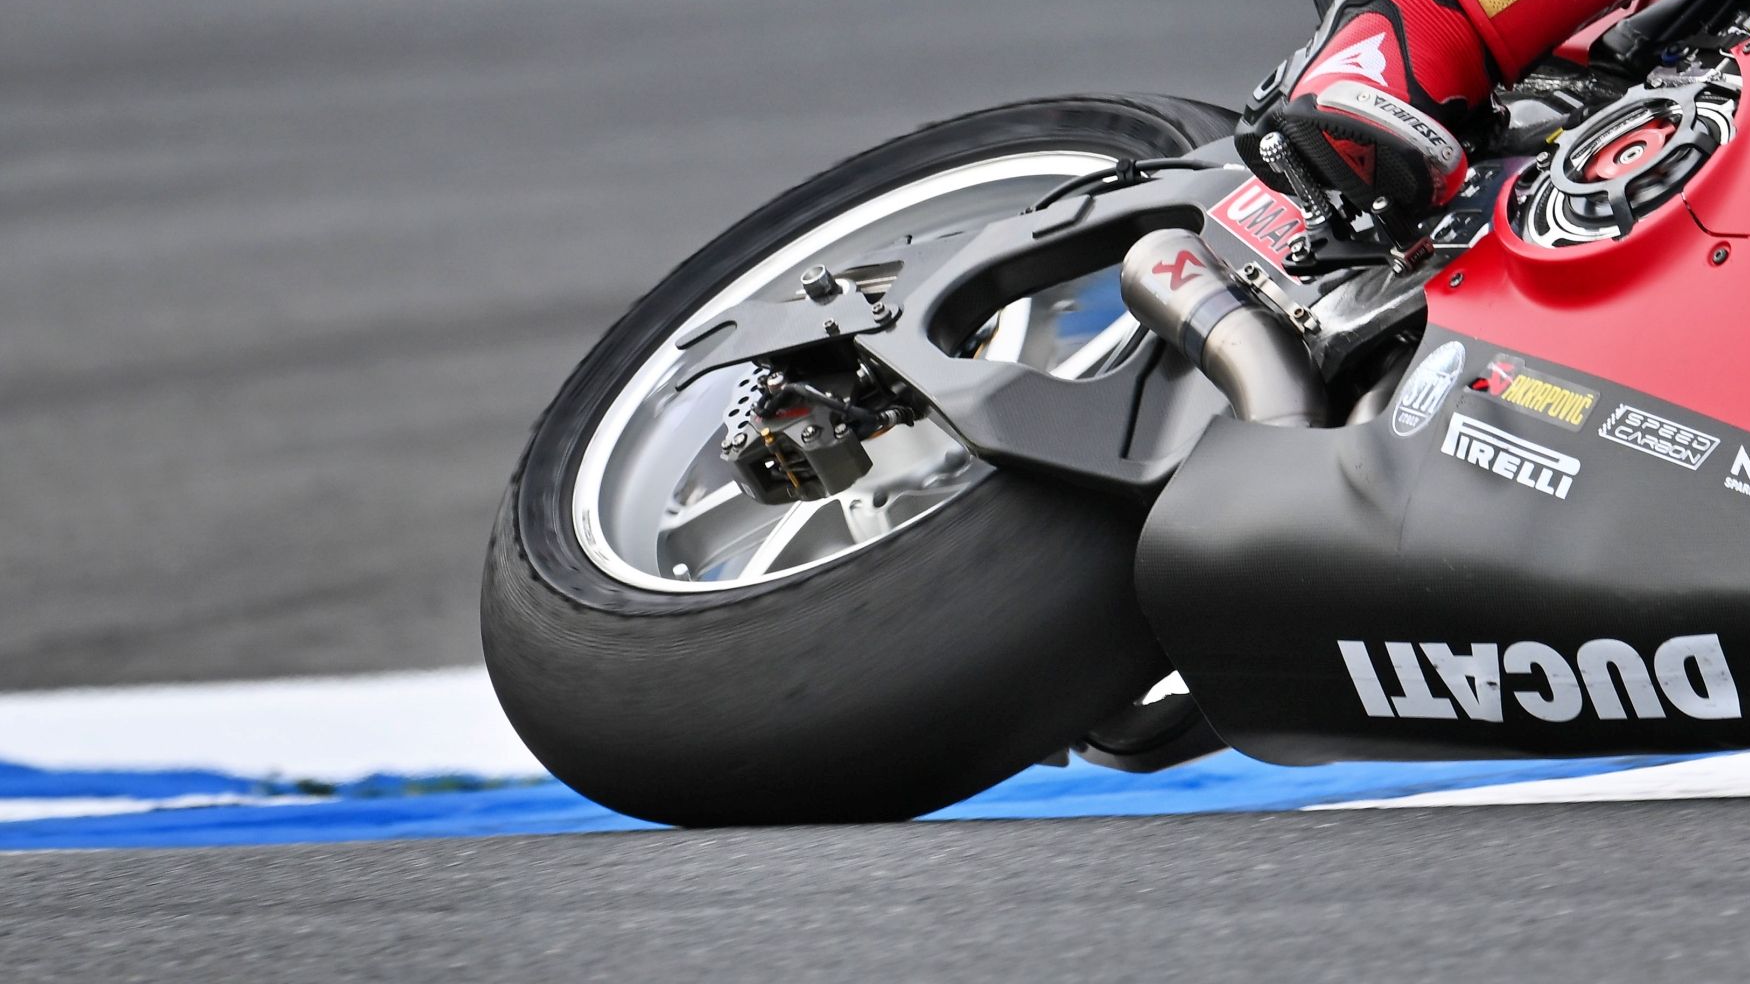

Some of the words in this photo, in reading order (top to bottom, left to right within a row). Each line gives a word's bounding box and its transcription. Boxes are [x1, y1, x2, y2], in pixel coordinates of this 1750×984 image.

[1226, 184, 1301, 255] UMA
[1501, 374, 1595, 426] AKRAPOVIČ
[1440, 411, 1582, 500] PIRELLI
[1614, 425, 1701, 464] CARBON
[1625, 412, 1711, 451] SPEED
[1336, 633, 1742, 723] DUCATI
